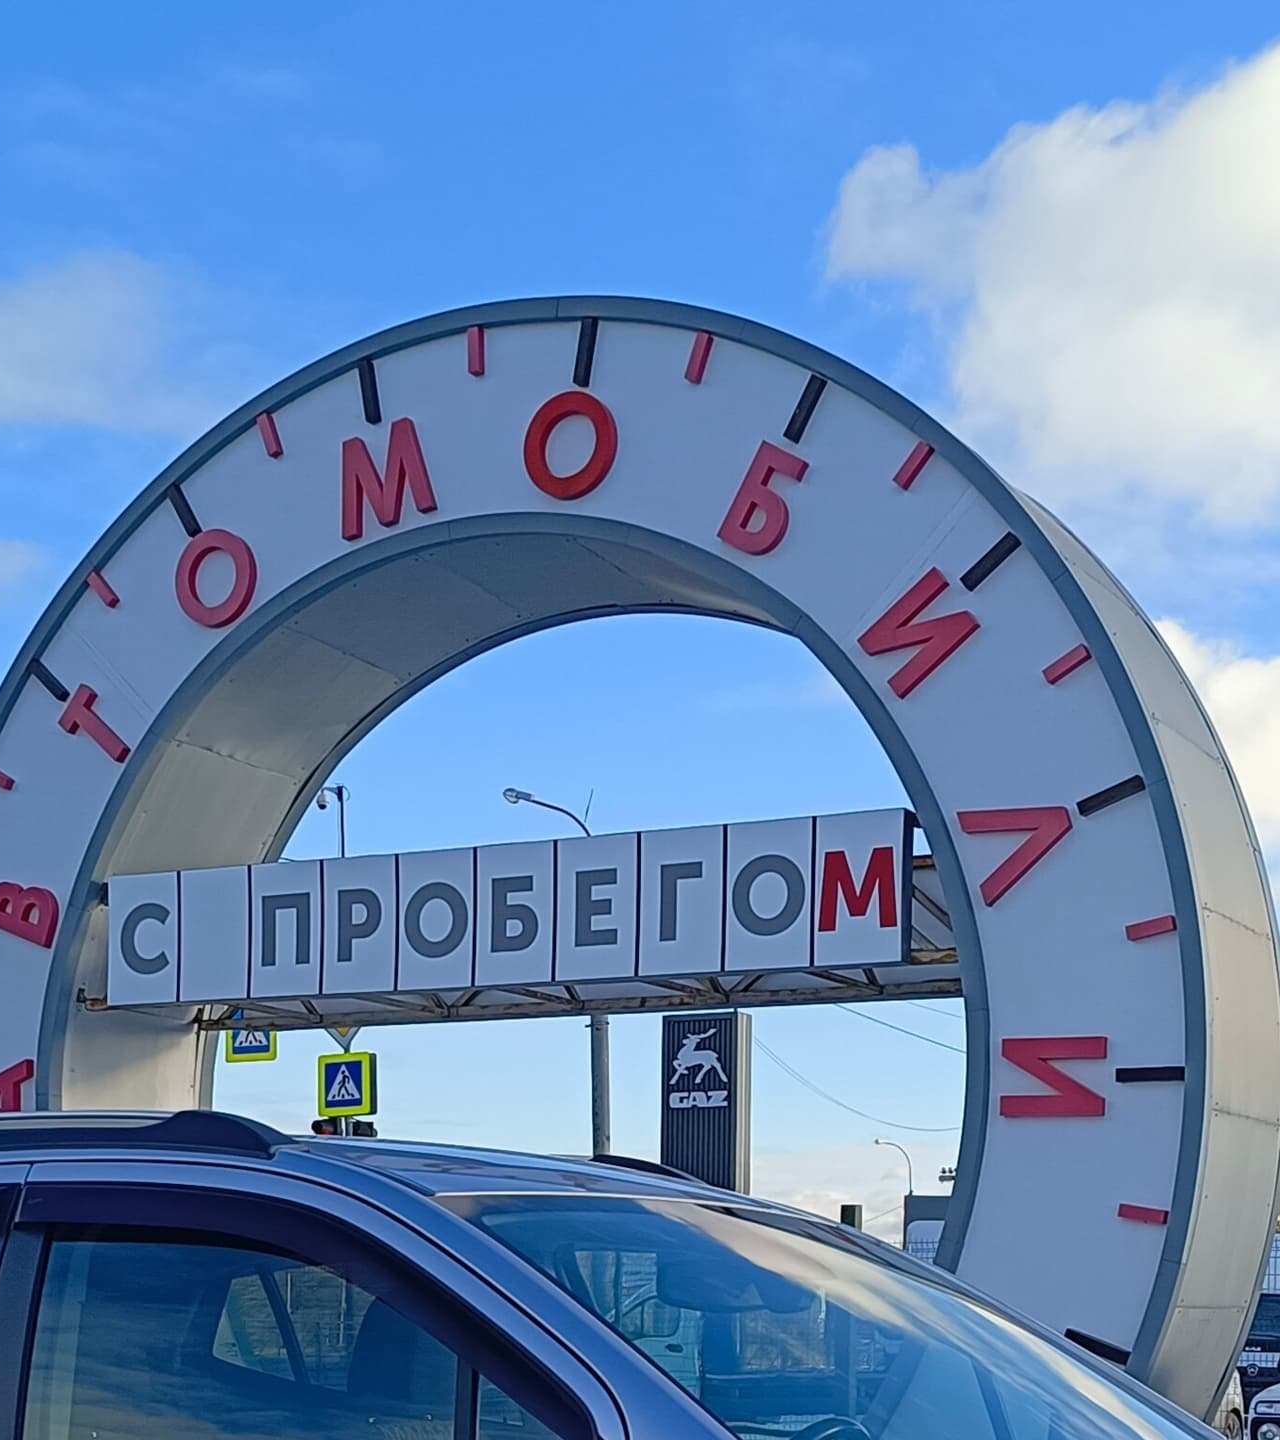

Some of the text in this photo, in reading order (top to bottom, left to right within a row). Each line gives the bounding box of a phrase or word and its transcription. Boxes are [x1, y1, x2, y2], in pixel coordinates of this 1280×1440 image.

[120, 845, 898, 975] С ПРОБЕГОМ
[669, 1090, 729, 1108] GAZ
